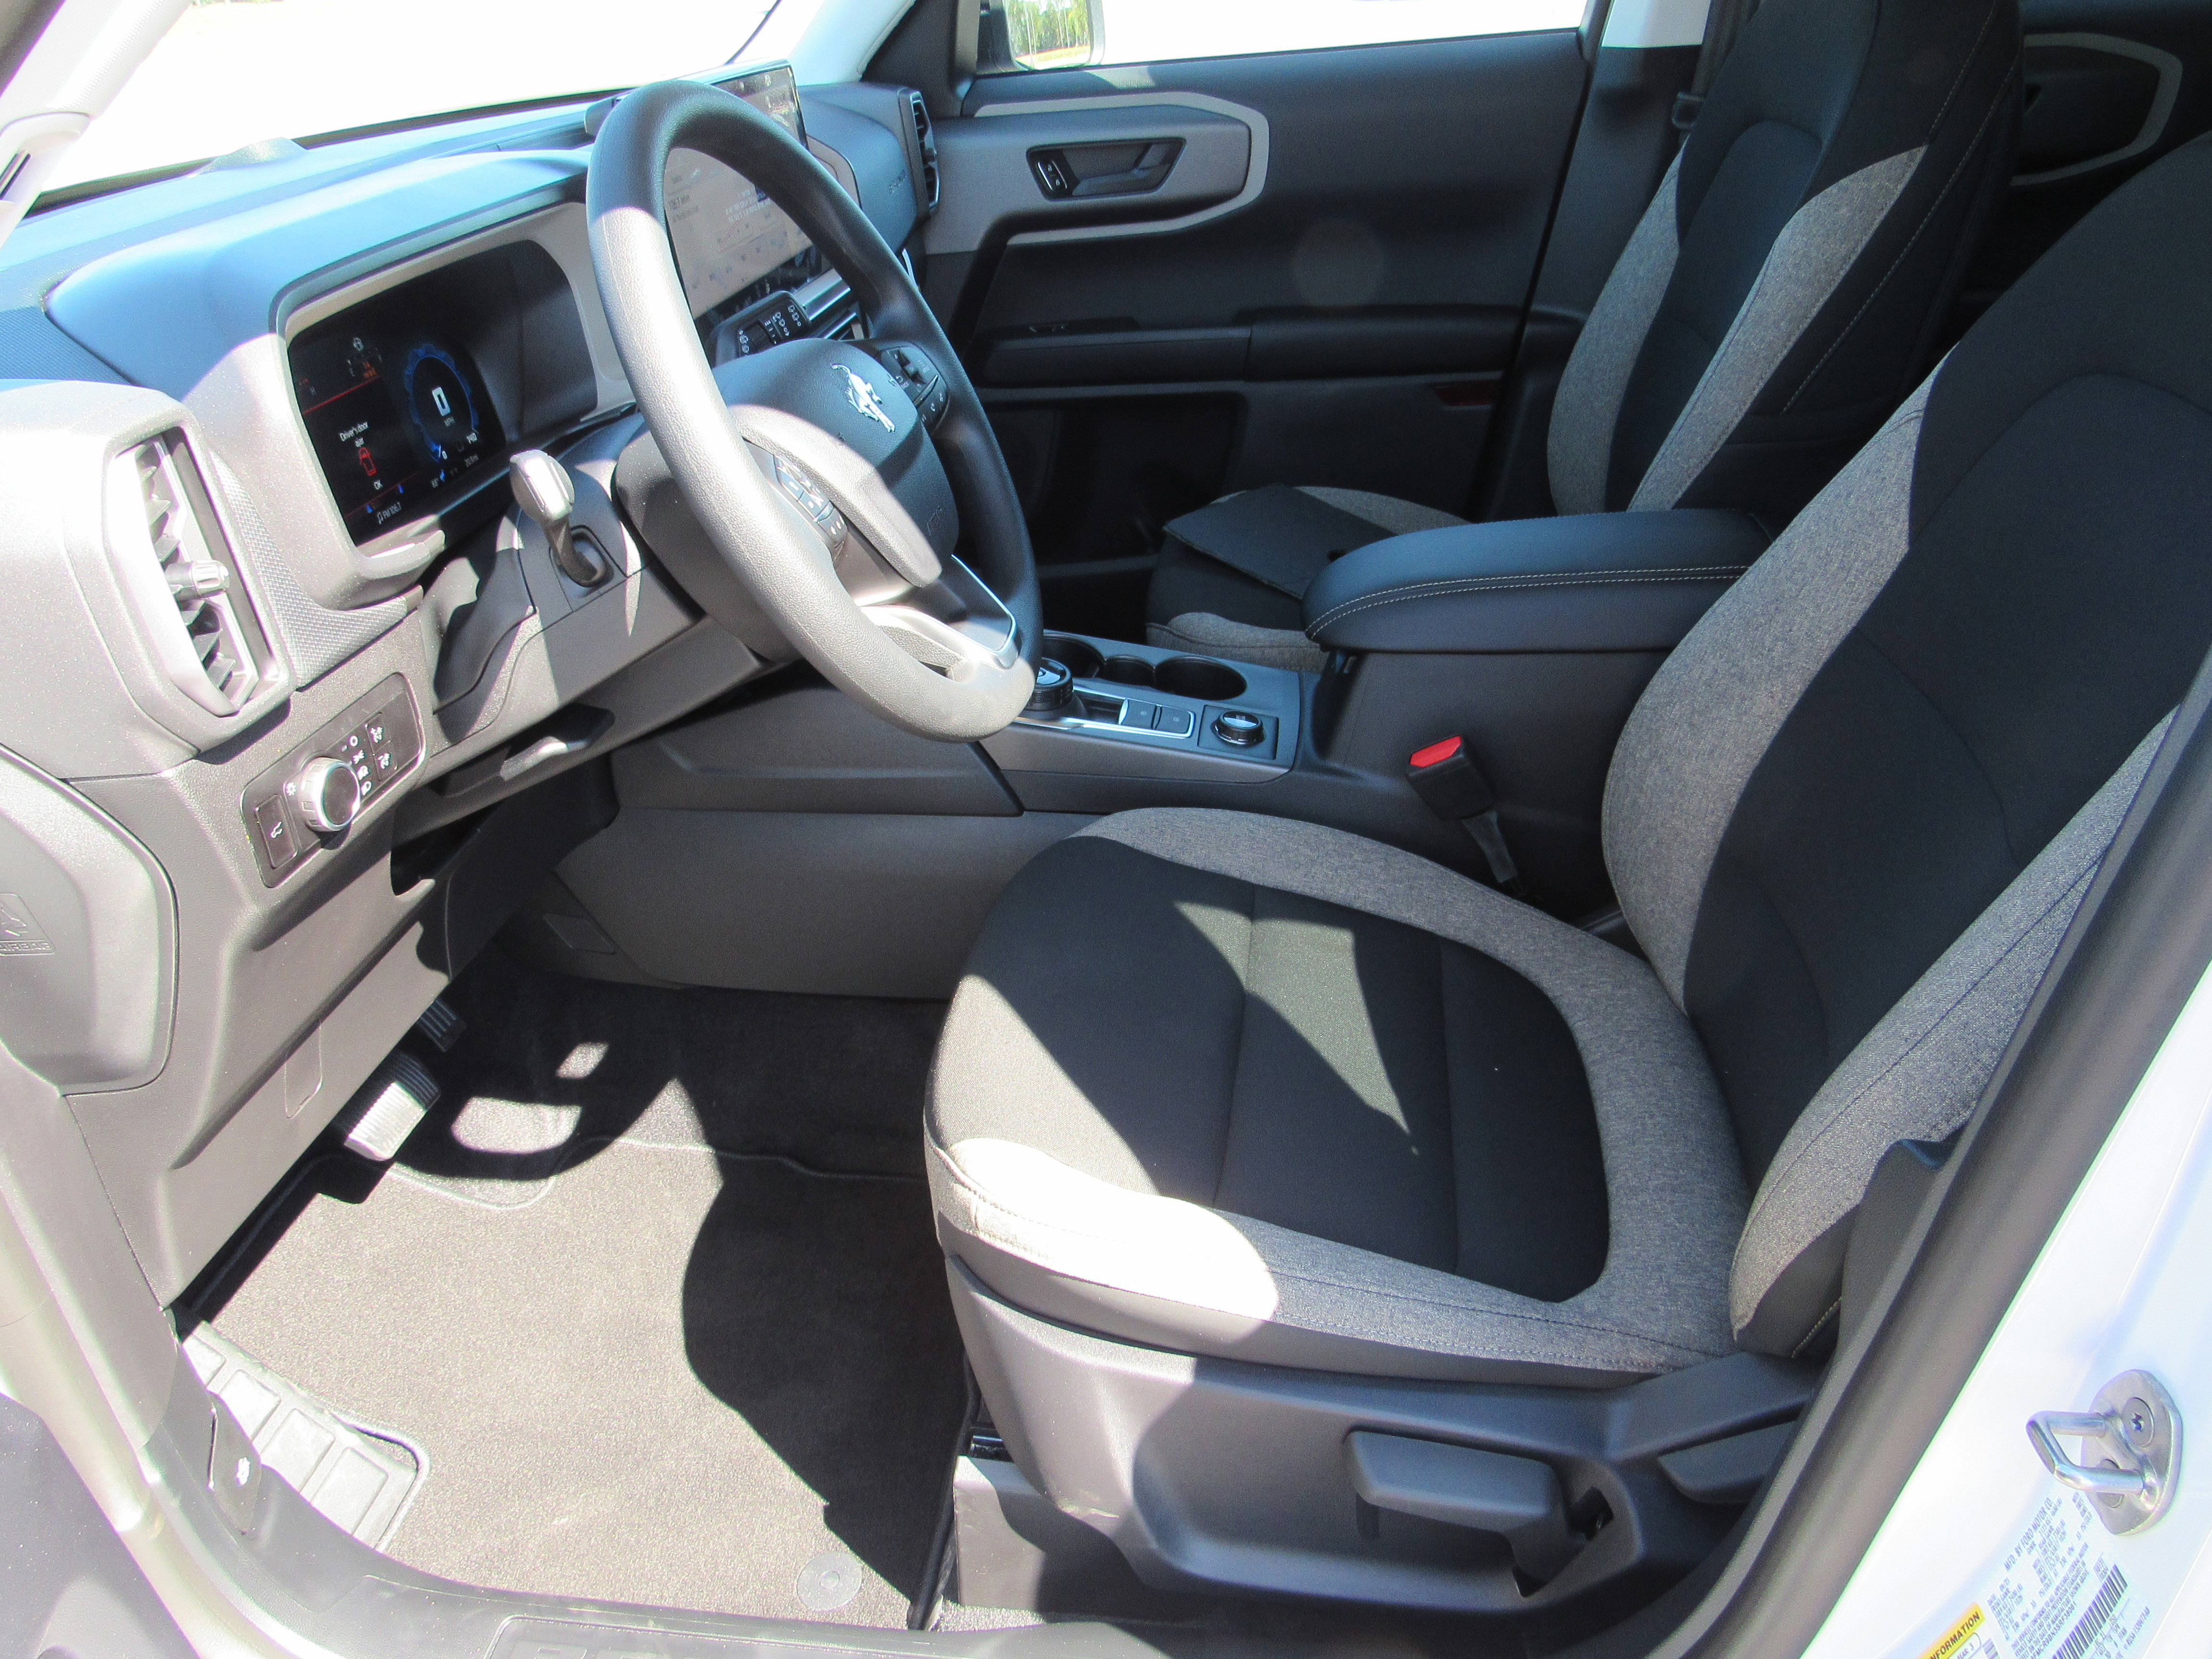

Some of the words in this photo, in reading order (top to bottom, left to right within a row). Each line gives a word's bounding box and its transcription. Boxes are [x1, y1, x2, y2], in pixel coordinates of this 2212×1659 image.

[432, 387, 451, 416] 0
[339, 426, 358, 441] Driver's
[358, 421, 369, 433] door
[373, 480, 383, 490] OK
[2014, 1543, 2023, 1557] BY
[2020, 1528, 2034, 1548] FORD
[2032, 1507, 2047, 1532] MOTOR
